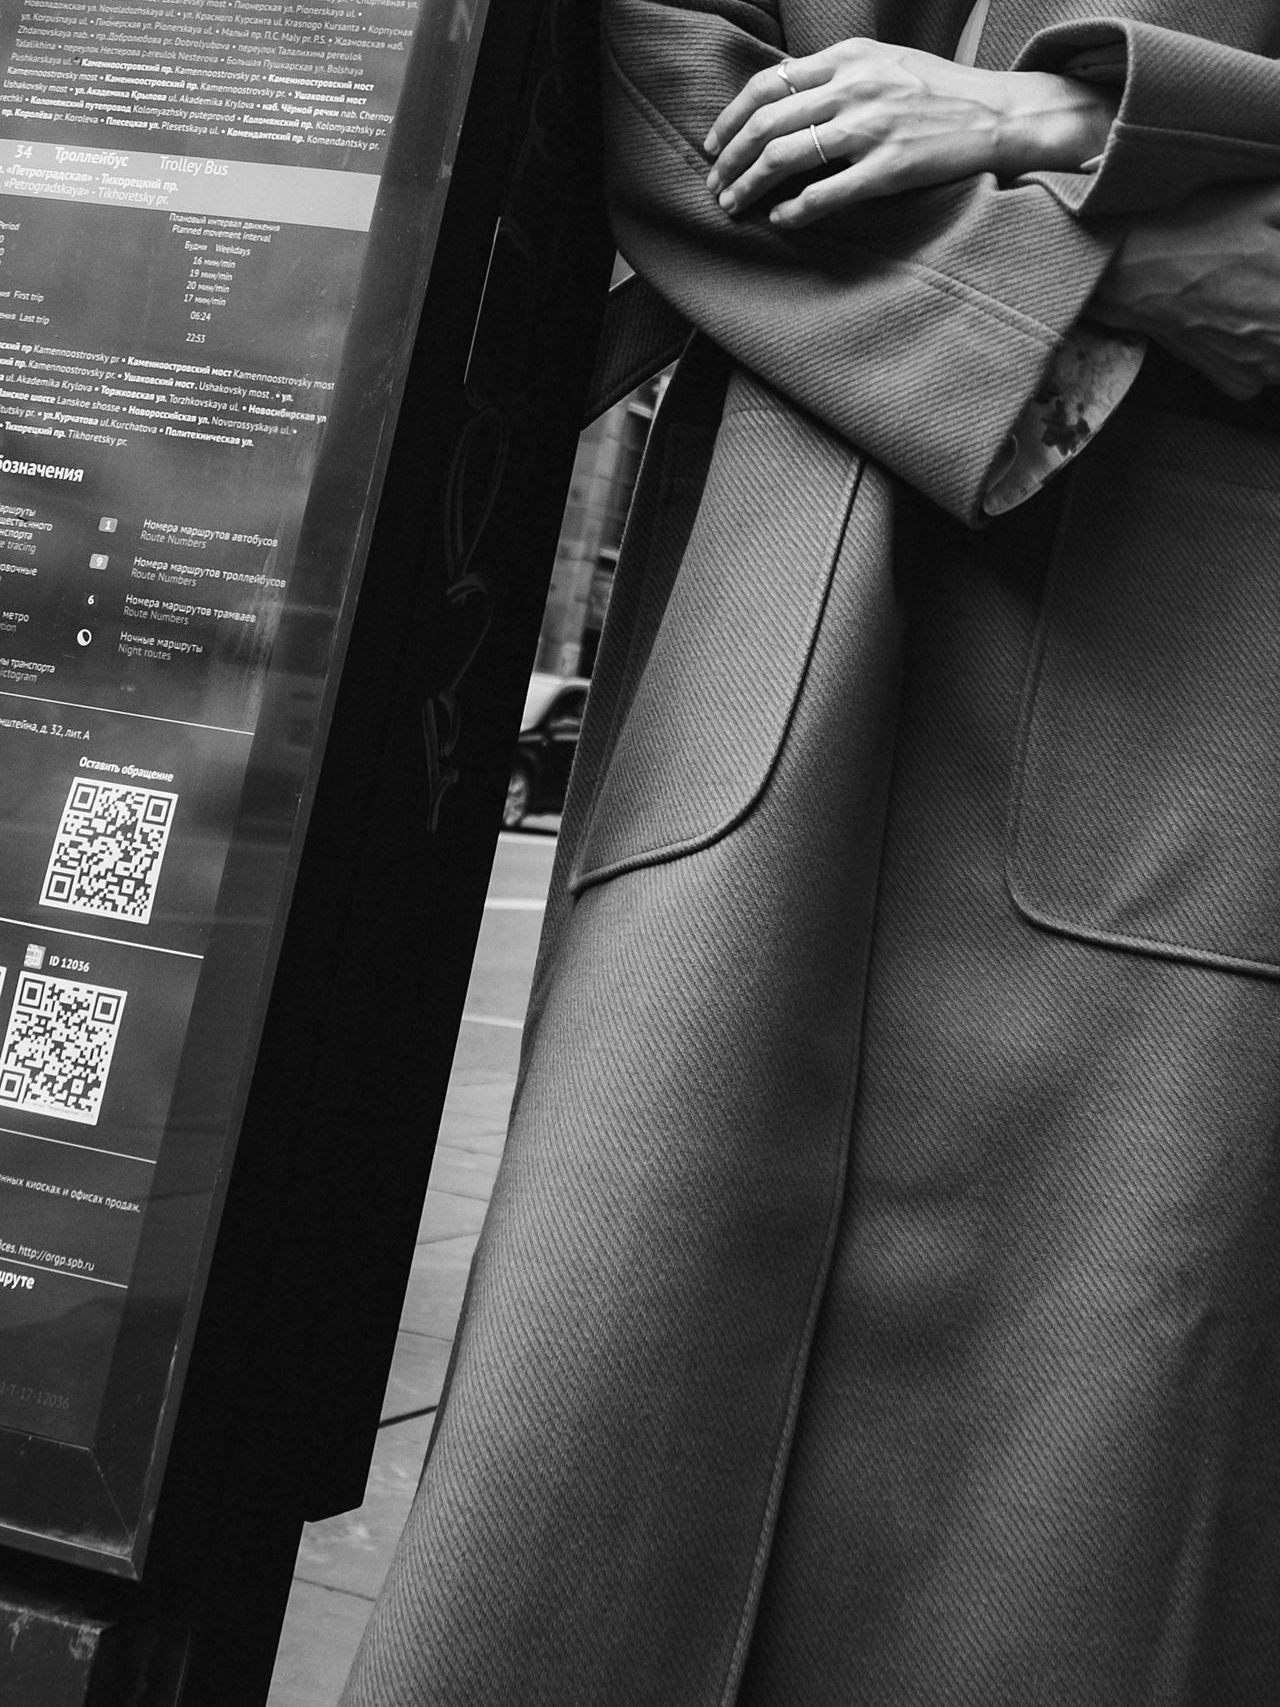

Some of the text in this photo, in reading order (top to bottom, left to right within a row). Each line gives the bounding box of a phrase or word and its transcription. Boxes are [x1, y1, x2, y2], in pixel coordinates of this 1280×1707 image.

[295, 4, 345, 19] Pionerskaya
[234, 14, 360, 33] Курсанта Kursanta
[14, 144, 231, 177] 34 Троллейбус Trolley Bus
[101, 173, 162, 190] Тихорецкий
[162, 181, 179, 194] пр.
[98, 186, 156, 206] Tikhoretsky
[155, 195, 169, 206] pr.
[215, 243, 252, 257] Weekdays
[192, 256, 203, 266] 16
[189, 268, 200, 278] 19
[185, 280, 197, 290] 20
[13, 290, 45, 303] First trip
[183, 293, 195, 303] 17
[18, 312, 50, 326] Last trip
[190, 310, 212, 322] 06:24
[185, 332, 206, 344] 22:53
[123, 371, 248, 398] Ушаковский Ushakovsky
[56, 395, 197, 423] Lanskoe shosse Новороссийская
[68, 428, 128, 447] Tikhoretsky pr.
[104, 520, 111, 531] 1
[143, 518, 279, 548] Номера маршрутов автобусов
[140, 529, 207, 549] Route Numbers
[96, 556, 104, 567] 9
[130, 567, 197, 587] Route Numbers
[133, 556, 287, 588] Номера маршрутов троллейбусов
[87, 594, 95, 605] 6
[125, 593, 257, 623] Номера маршрутов трамваев
[2, 611, 30, 623] метро
[123, 605, 189, 625] Route Numbers
[119, 631, 203, 654] Ночные маршруты
[117, 643, 172, 661] Night routes
[11, 658, 56, 674] транспорта
[49, 723, 90, 741] 32, А
[78, 756, 174, 783] Оставить обращение
[48, 955, 90, 973] ID 12036
[25, 1180, 141, 1213] киосках и офисах продаж.
[17, 1244, 95, 1272] http://orgp.spb.ru
